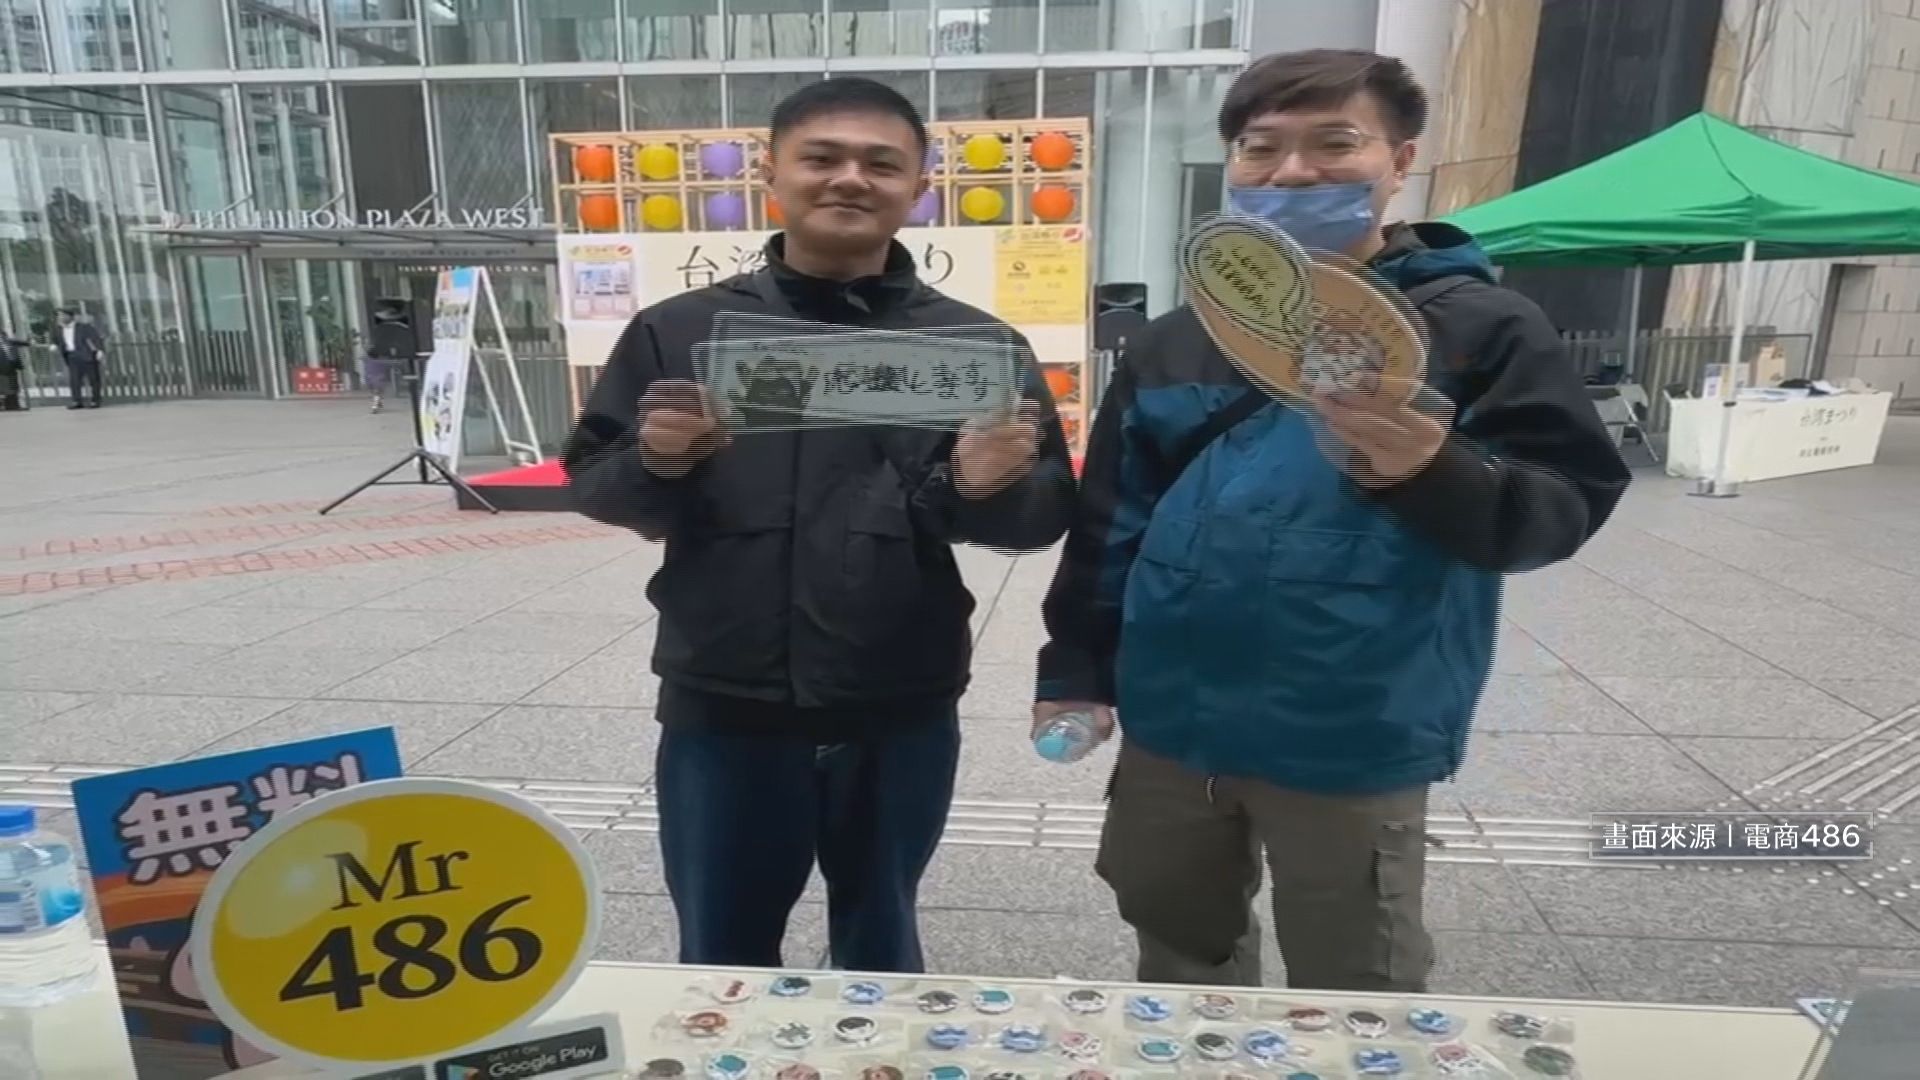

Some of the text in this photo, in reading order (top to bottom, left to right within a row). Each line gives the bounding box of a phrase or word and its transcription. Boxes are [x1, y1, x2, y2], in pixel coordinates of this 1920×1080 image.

[366, 208, 455, 229] PLAZA
[461, 207, 545, 229] WEST
[325, 841, 470, 911] Mr
[279, 895, 542, 1012] 486
[489, 1044, 597, 1077] Google Play
